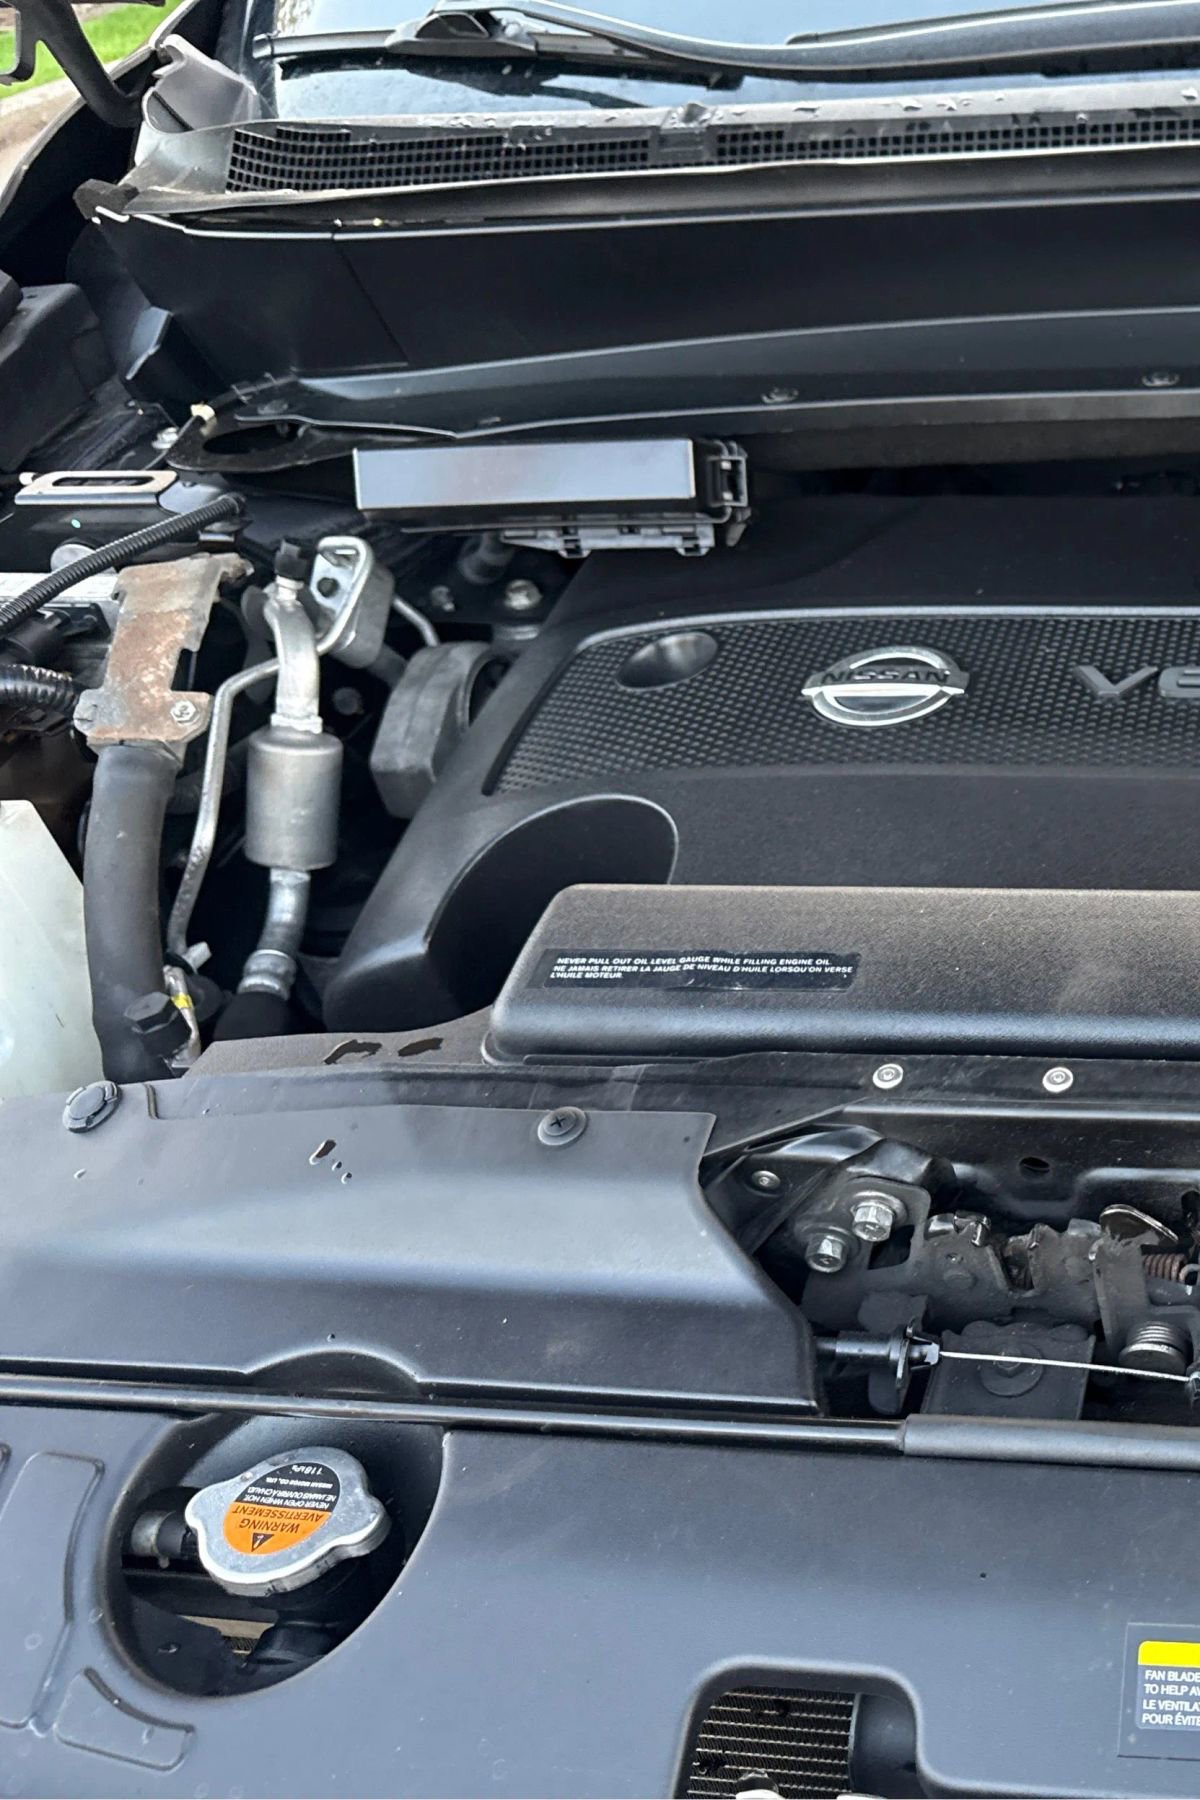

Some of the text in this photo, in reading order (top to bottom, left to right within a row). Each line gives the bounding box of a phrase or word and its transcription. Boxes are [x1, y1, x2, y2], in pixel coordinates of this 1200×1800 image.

[820, 668, 952, 684] NISSAN
[557, 957, 587, 965] NEVER
[588, 957, 611, 965] PULL
[612, 957, 632, 965] OUT
[633, 957, 649, 965] OIL
[650, 957, 677, 965] LEVEL
[679, 955, 711, 964] GAUGE
[712, 956, 742, 965] WHILE
[743, 958, 778, 966] FILLING
[779, 958, 814, 966] ENGINE
[553, 963, 854, 974] NE JAMAIS RETIRER LA JAUGE DE NIVEAU D'HUILE LORSQU'ON VERSE
[549, 971, 584, 980] L'HUILE
[277, 1490, 303, 1498] OUVRIR
[303, 1493, 325, 1501] JAMAIS
[260, 1497, 283, 1505] WHEN
[285, 1500, 305, 1508] OPEN
[304, 1501, 330, 1510] NEVER
[232, 1505, 325, 1523] AVERTISSEMENT
[239, 1518, 301, 1534] WARNING
[1144, 1669, 1166, 1682] FAN
[1144, 1683, 1160, 1695] TO
[1161, 1684, 1189, 1697] HELP
[1142, 1699, 1157, 1711] LE
[1141, 1713, 1174, 1726] POUR
